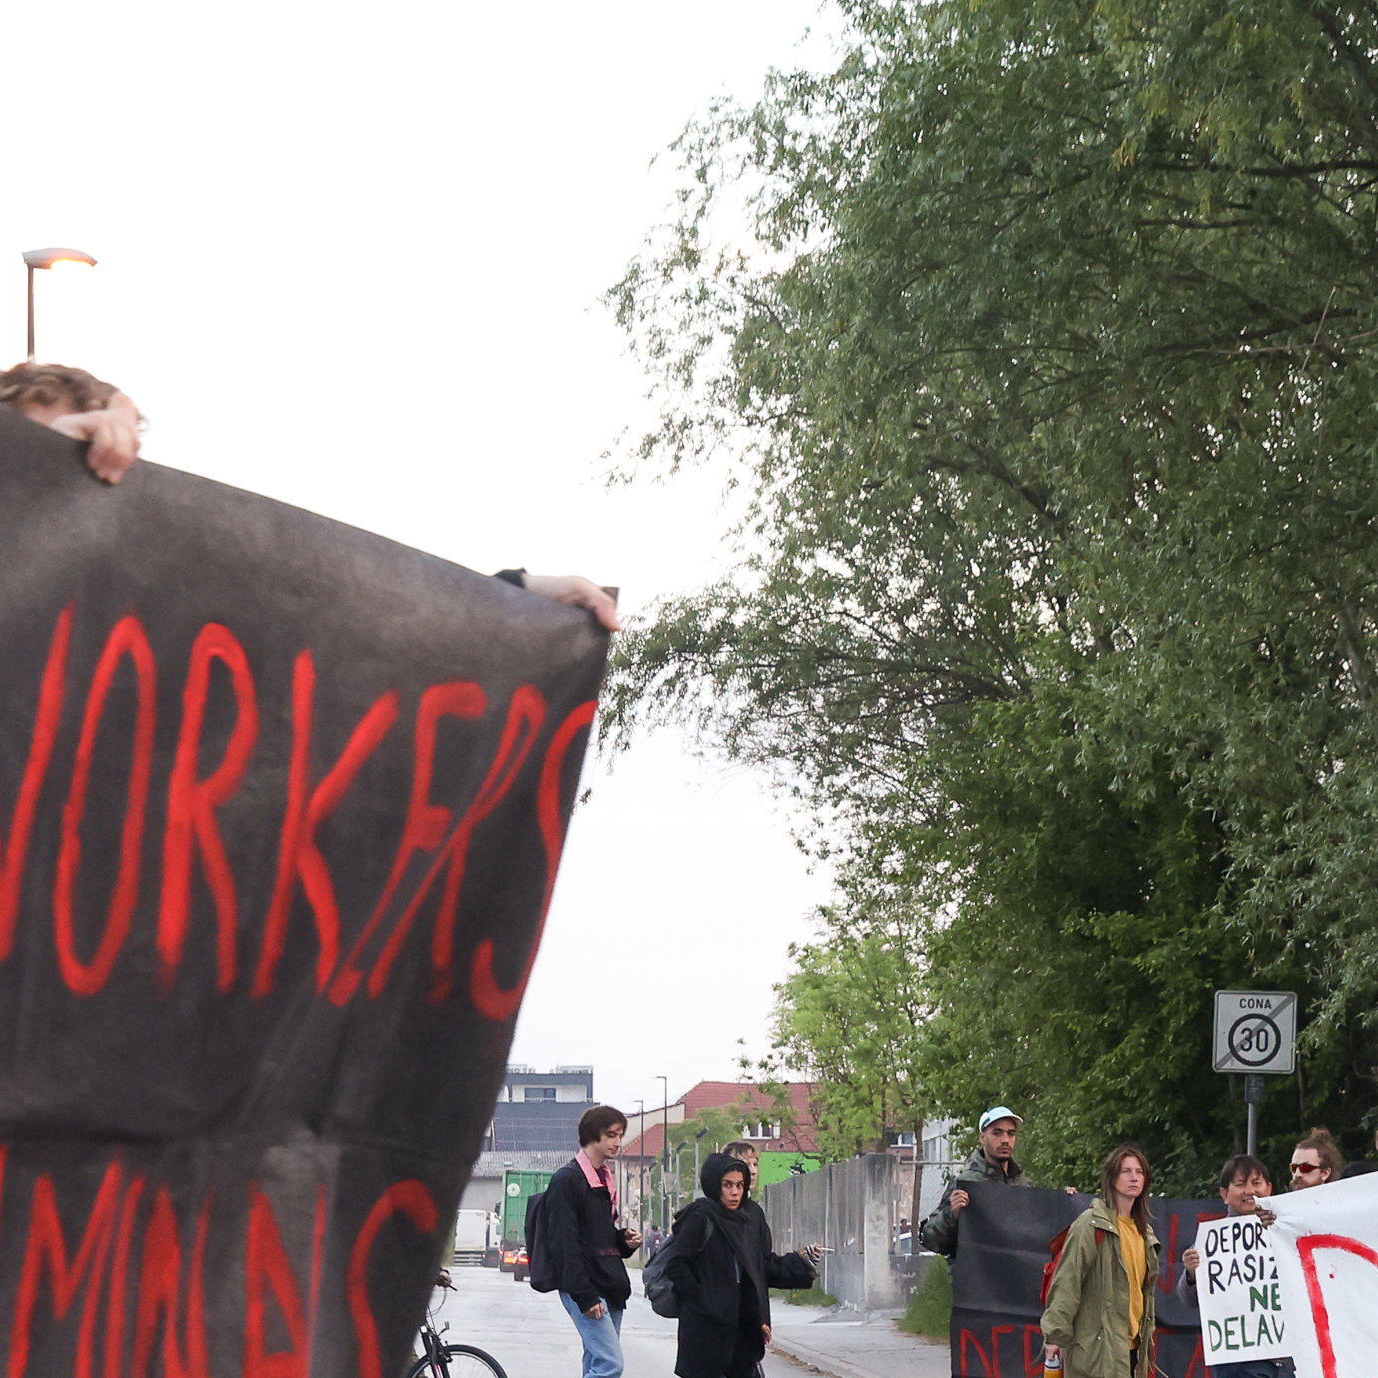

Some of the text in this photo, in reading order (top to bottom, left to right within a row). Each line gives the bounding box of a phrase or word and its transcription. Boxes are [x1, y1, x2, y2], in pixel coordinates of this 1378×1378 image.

[1239, 998, 1272, 1010] CONA
[1240, 1028, 1269, 1052] 30
[1205, 1222, 1273, 1258] DEPOR
